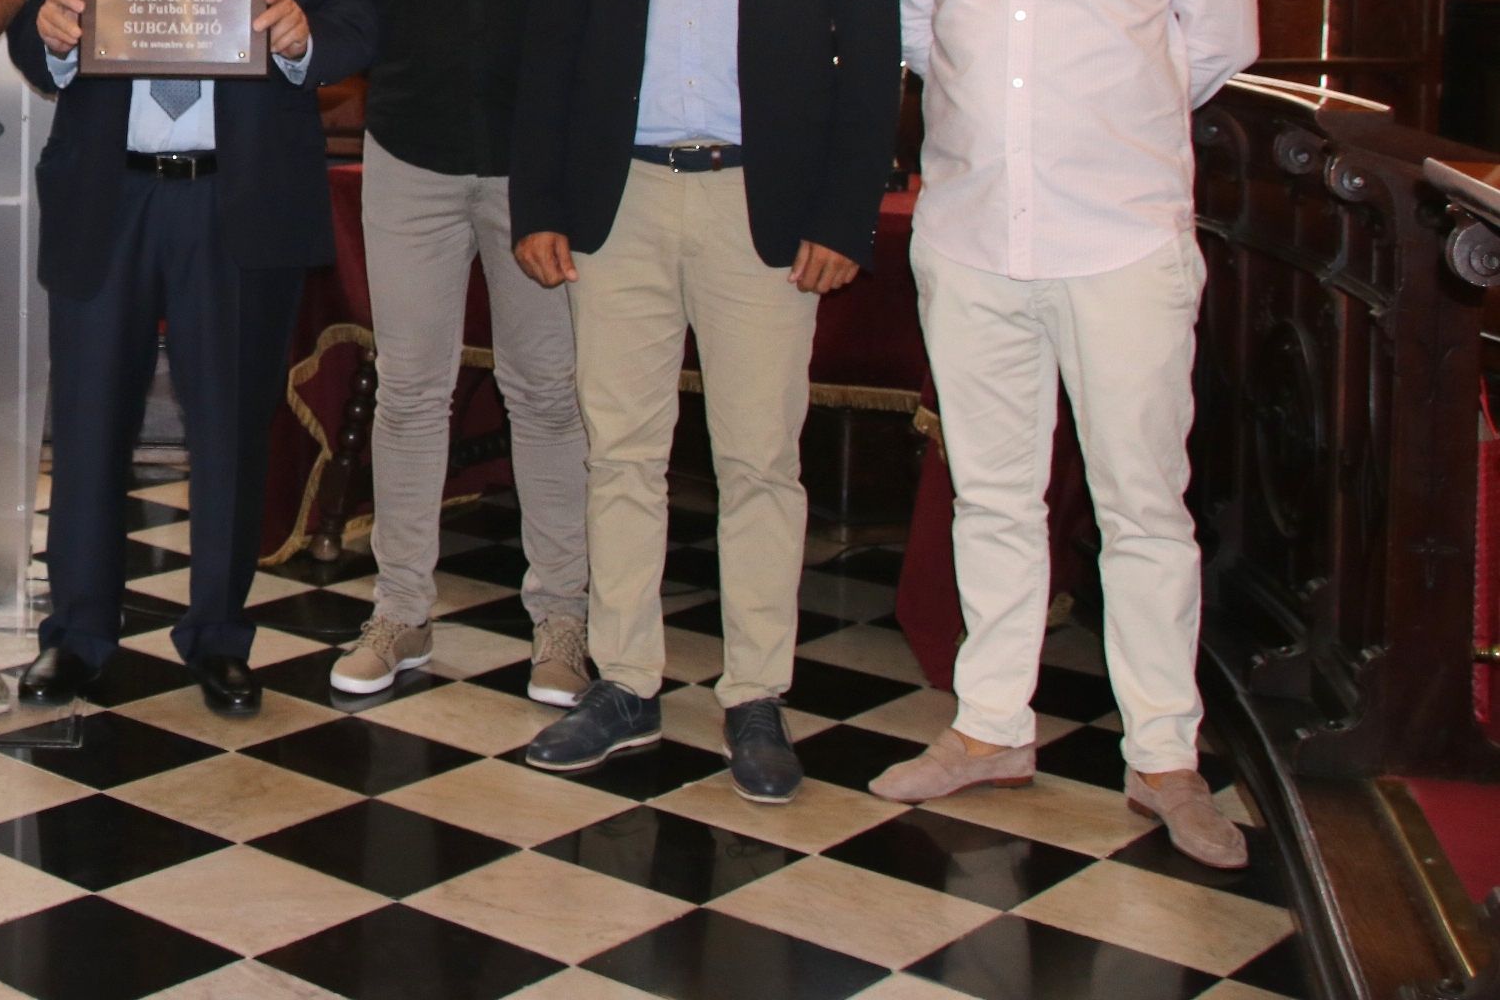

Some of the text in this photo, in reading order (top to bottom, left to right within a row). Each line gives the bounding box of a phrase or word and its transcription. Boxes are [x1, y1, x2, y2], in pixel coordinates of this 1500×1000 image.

[129, 4, 217, 15] de Futbol Sala
[124, 19, 222, 35] SUBCAMPIÓ
